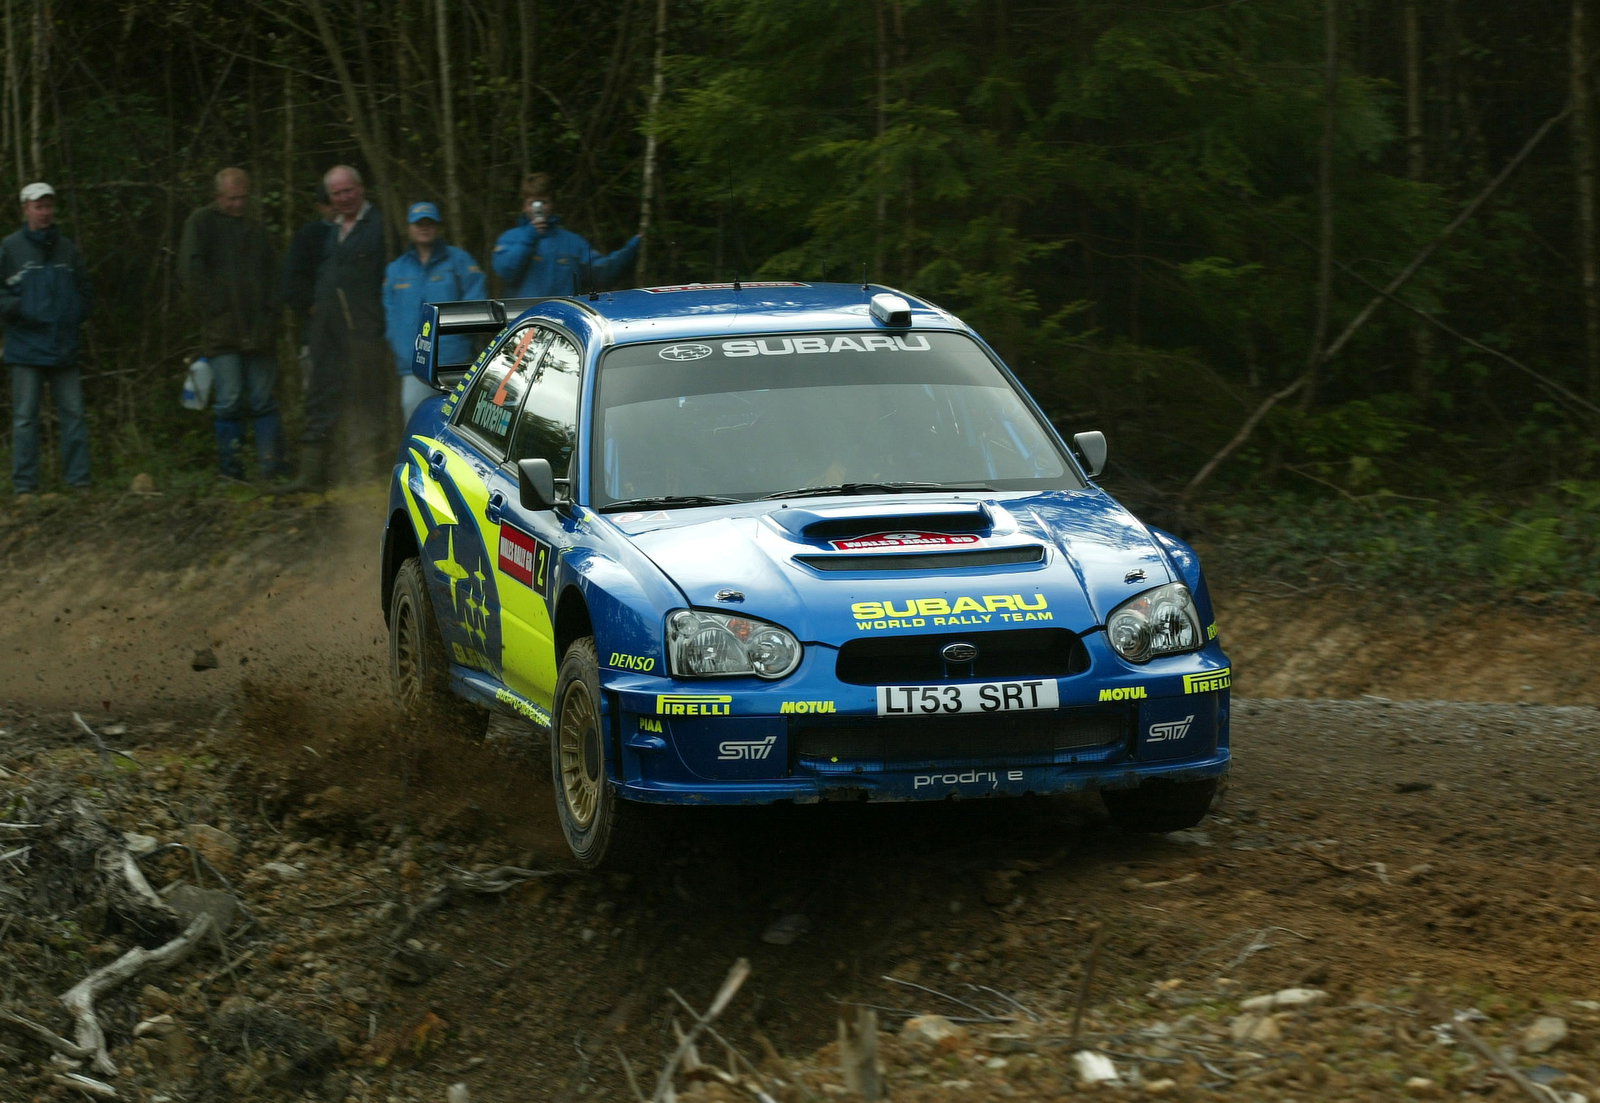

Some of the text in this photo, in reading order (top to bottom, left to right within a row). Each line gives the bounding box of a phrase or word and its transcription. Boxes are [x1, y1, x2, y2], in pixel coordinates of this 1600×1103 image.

[722, 335, 931, 357] SUBARU
[491, 327, 535, 406] 2
[537, 549, 545, 587] 2
[851, 593, 1048, 620] SUBARU
[856, 610, 1054, 631] WORLD RALLY TEAM
[609, 652, 655, 671] DENSO
[656, 694, 732, 715] PIRELLI
[886, 681, 1044, 714] LT53 SRT
[1098, 686, 1148, 702] MOTUL
[780, 700, 836, 714] MOTUL
[639, 717, 663, 733] PIAA
